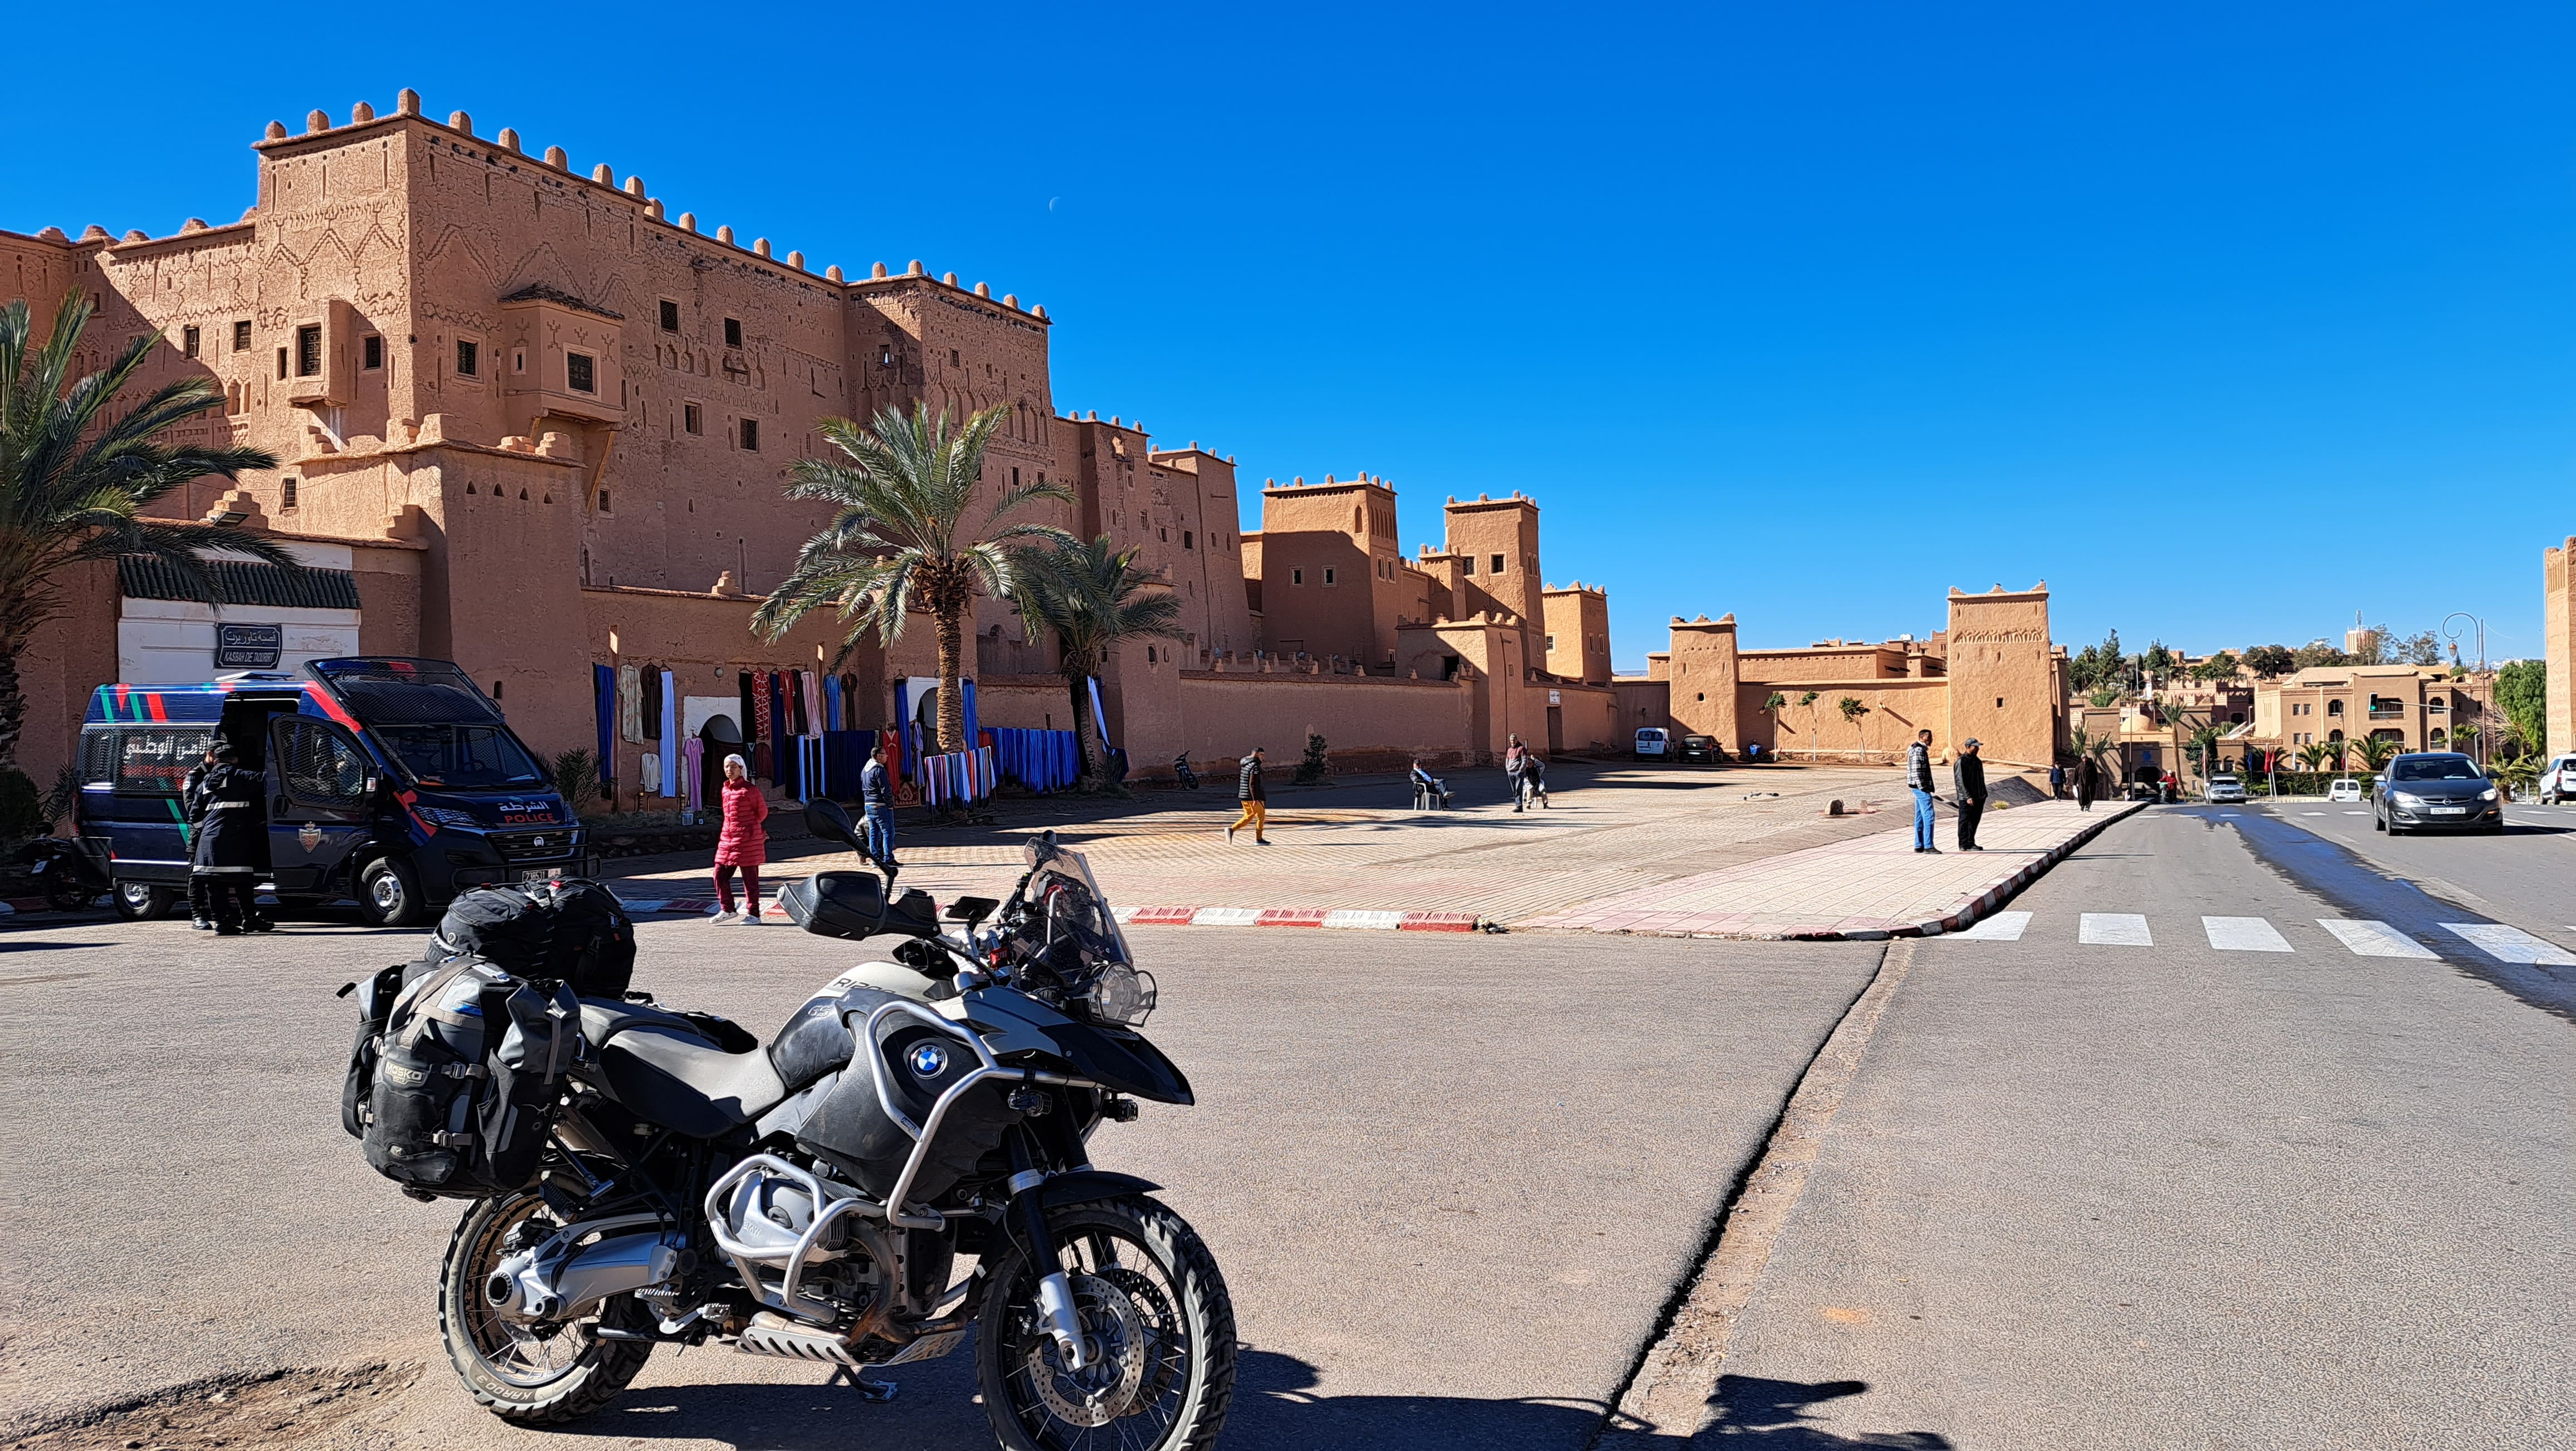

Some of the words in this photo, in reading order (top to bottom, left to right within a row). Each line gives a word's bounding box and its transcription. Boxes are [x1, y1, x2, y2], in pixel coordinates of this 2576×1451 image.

[226, 631, 257, 645] تاوريرت
[224, 651, 245, 662] KASBAH
[245, 651, 253, 662] DE
[497, 801, 550, 812] الشرطة
[504, 813, 555, 824] POLICE
[808, 1005, 833, 1017] GS
[920, 1047, 943, 1062] BMW
[384, 1061, 423, 1081] MOSKO
[1022, 1314, 1032, 1336] BMW
[476, 1375, 488, 1384] 3
[485, 1382, 533, 1400] KAROO
